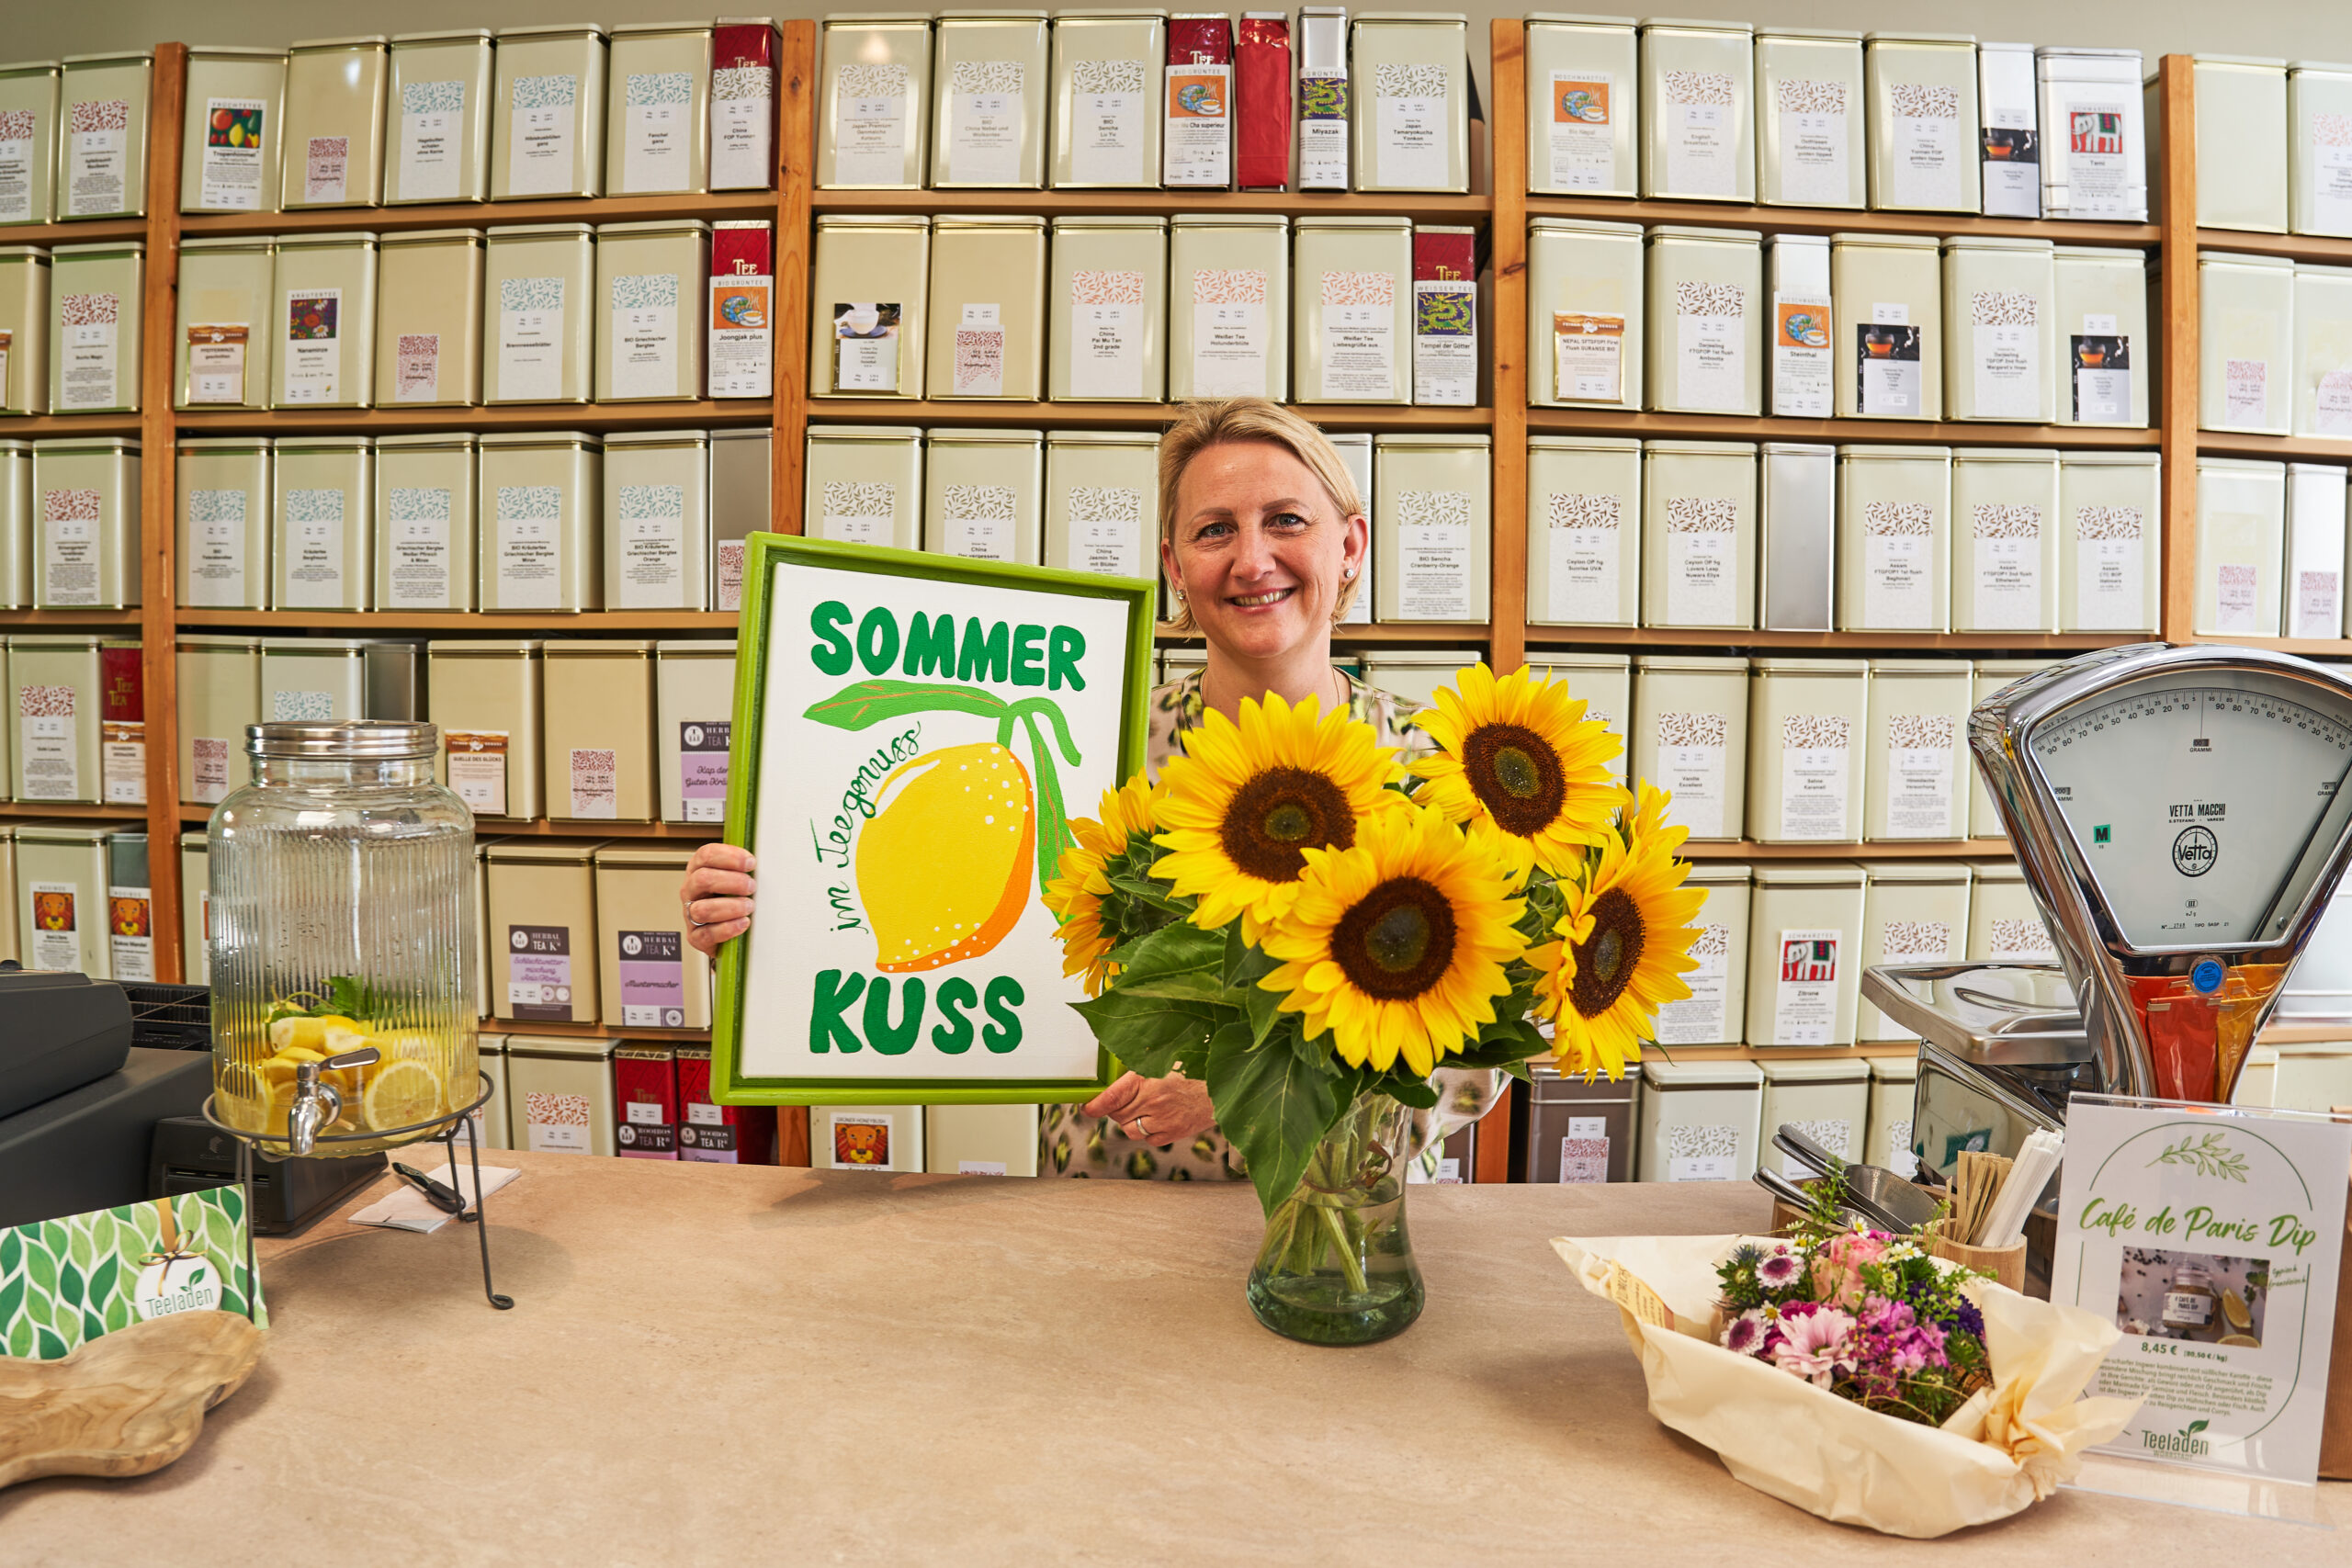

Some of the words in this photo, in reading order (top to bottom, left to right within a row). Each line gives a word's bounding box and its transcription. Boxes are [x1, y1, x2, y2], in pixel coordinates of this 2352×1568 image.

[732, 259, 758, 275] TEE
[1435, 265, 1461, 281] TEE
[810, 600, 1087, 692] SOMMER
[2047, 746, 2057, 755] 90
[2062, 738, 2072, 746] 80
[2078, 730, 2088, 739] 70
[2094, 723, 2104, 732] 60
[2111, 717, 2121, 725] 50
[2266, 711, 2276, 719] 60
[2325, 735, 2334, 743] 20
[810, 721, 922, 868] Teegenuss
[2169, 805, 2193, 817] VETTA
[2198, 803, 2226, 816] MACCHI
[2096, 828, 2108, 841] M
[2179, 844, 2212, 861] Vetta
[810, 968, 1025, 1056] KUSS
[2079, 1197, 2137, 1238] Café
[2145, 1206, 2177, 1236] de
[2184, 1206, 2259, 1242] Paris
[2267, 1214, 2316, 1256] Dip
[146, 1288, 213, 1317] Teeladen
[2141, 1341, 2167, 1355] 8,45
[2170, 1345, 2177, 1356] €
[2142, 1430, 2209, 1455] Teeladen
